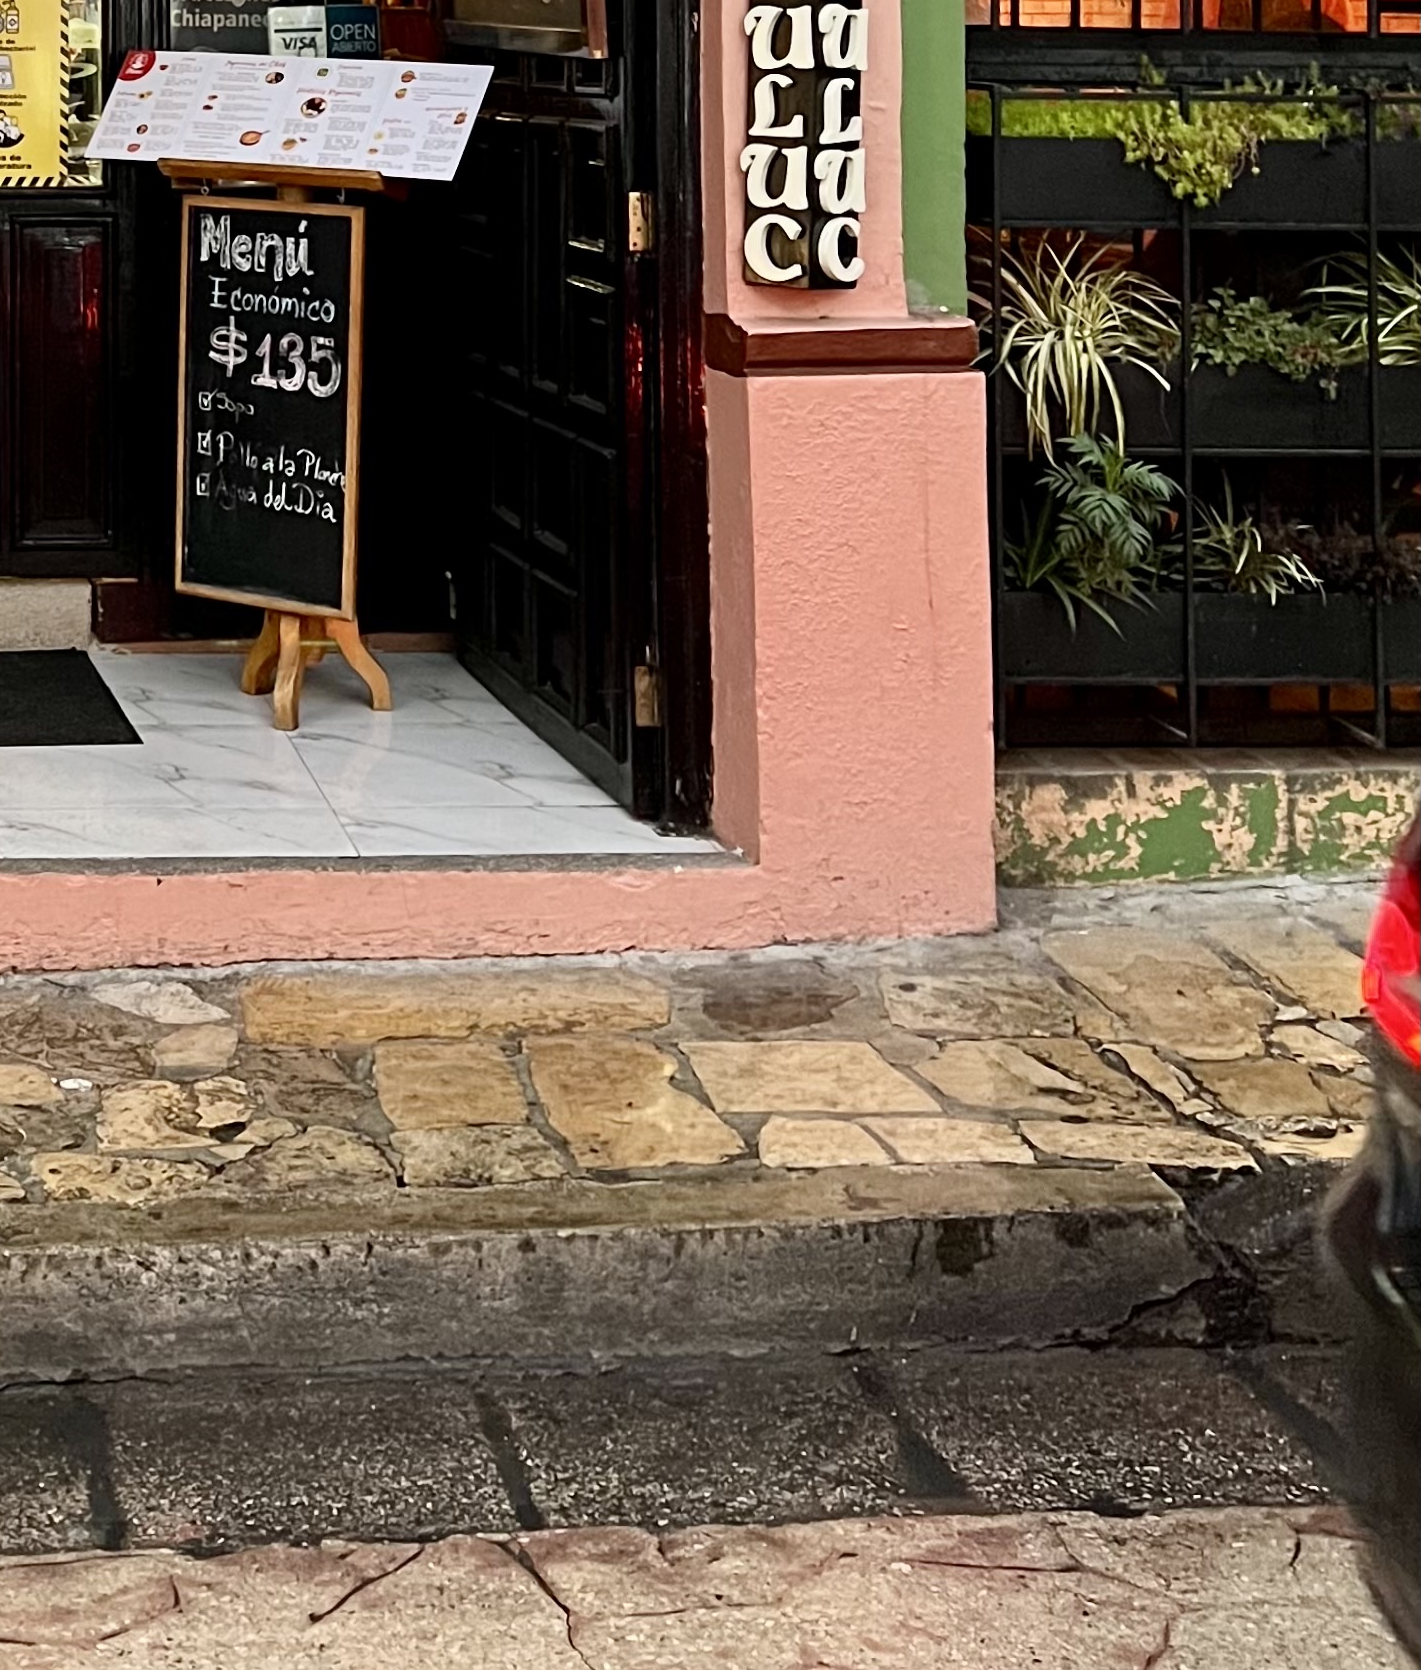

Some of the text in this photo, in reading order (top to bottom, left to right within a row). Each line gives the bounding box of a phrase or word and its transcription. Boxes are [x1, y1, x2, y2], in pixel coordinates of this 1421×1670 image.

[281, 35, 318, 51] VISA
[330, 23, 377, 41] OPEN
[331, 40, 377, 53] ABIERTO
[199, 213, 314, 282] Menú
[208, 274, 336, 323] Económico
[215, 431, 259, 468] Pllo
[261, 454, 275, 474] a
[278, 444, 296, 477] la
[263, 478, 294, 512] del
